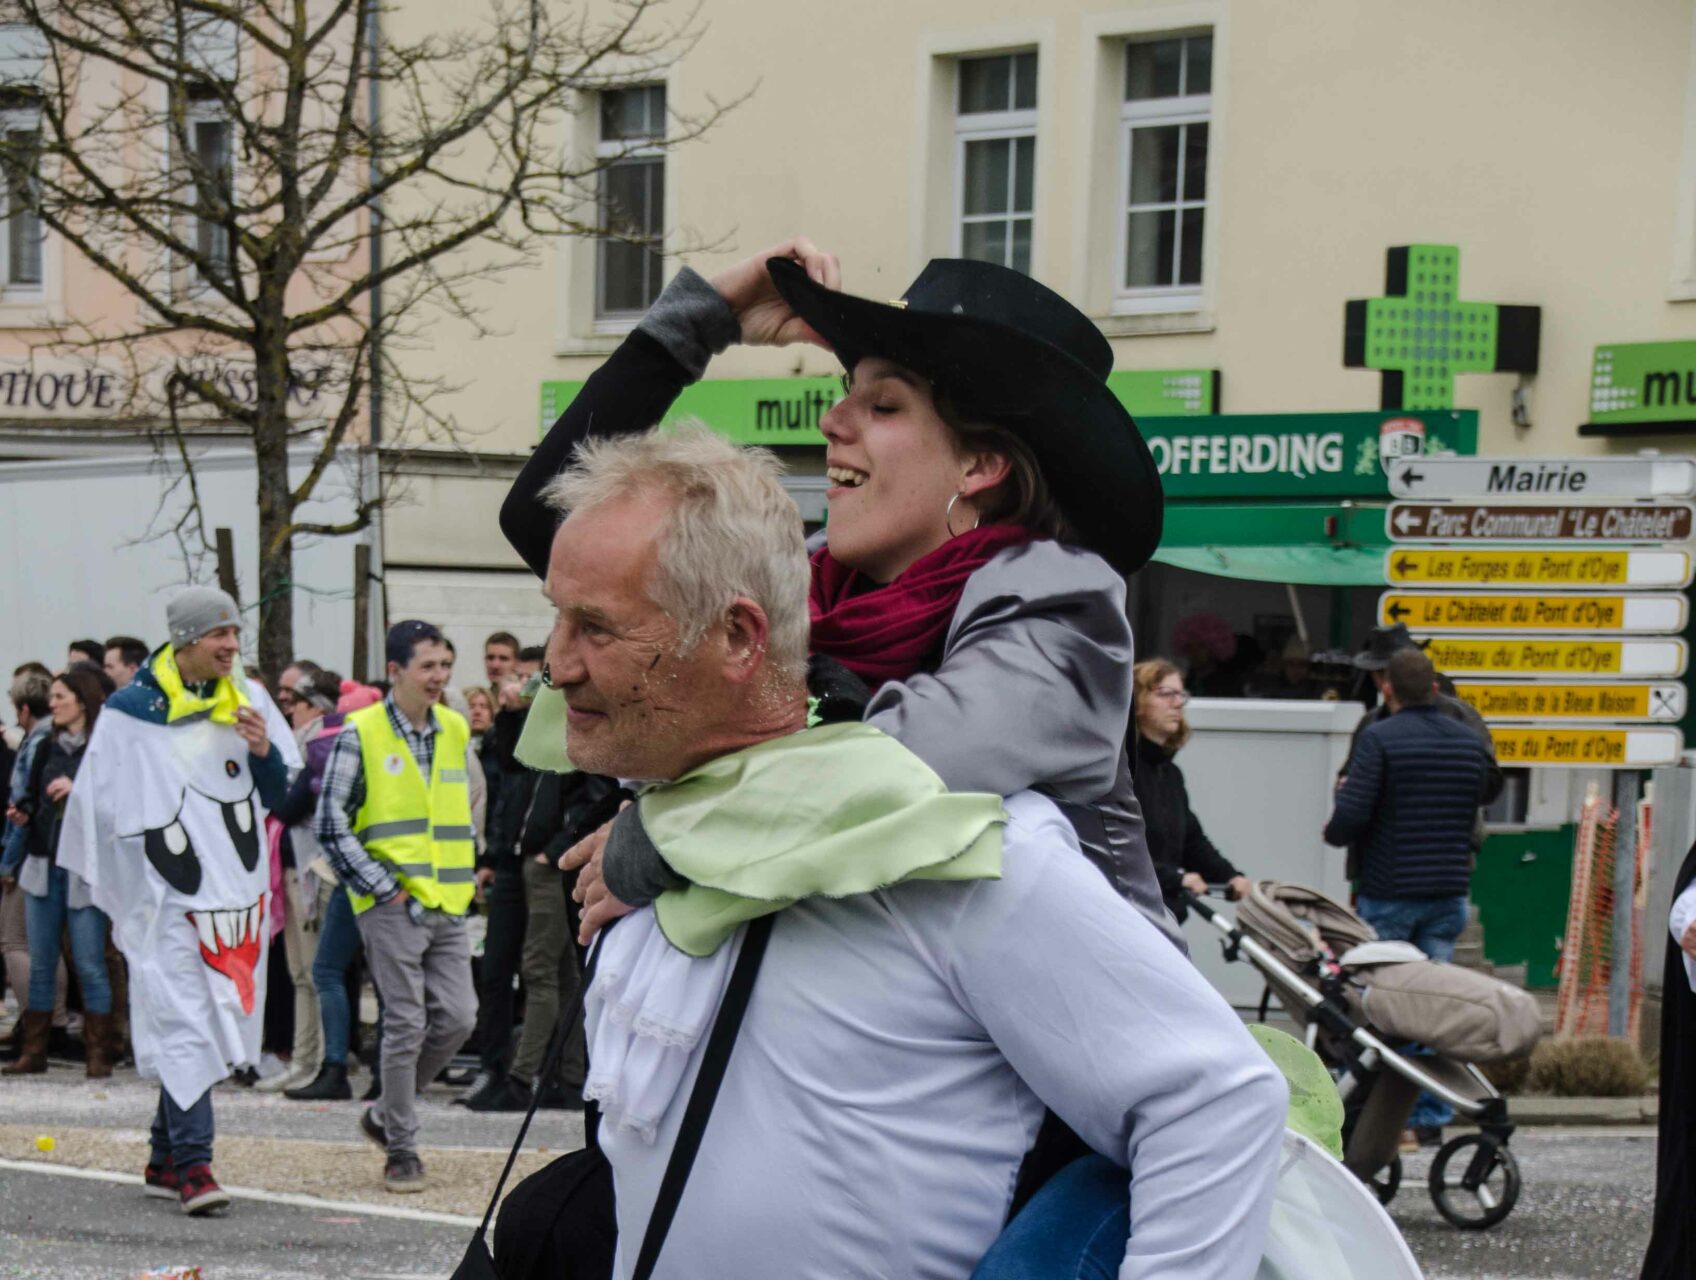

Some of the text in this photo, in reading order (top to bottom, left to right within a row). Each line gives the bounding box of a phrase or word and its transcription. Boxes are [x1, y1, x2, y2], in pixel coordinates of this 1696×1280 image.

[0, 369, 116, 410] TIQUE
[1487, 465, 1586, 492] Mairie
[1427, 508, 1467, 536] Parc
[1470, 508, 1563, 536] Communal
[1427, 557, 1620, 583] Les Forges du Pont d'Oye
[1424, 601, 1614, 628] Le Châtelet du Pont d'Oye
[1491, 645, 1513, 667] du
[1522, 645, 1560, 667] Pont
[1565, 645, 1612, 672] d'Oye
[1522, 736, 1538, 757] du
[1545, 735, 1578, 757] Pont
[1582, 735, 1622, 762] d'Oye
